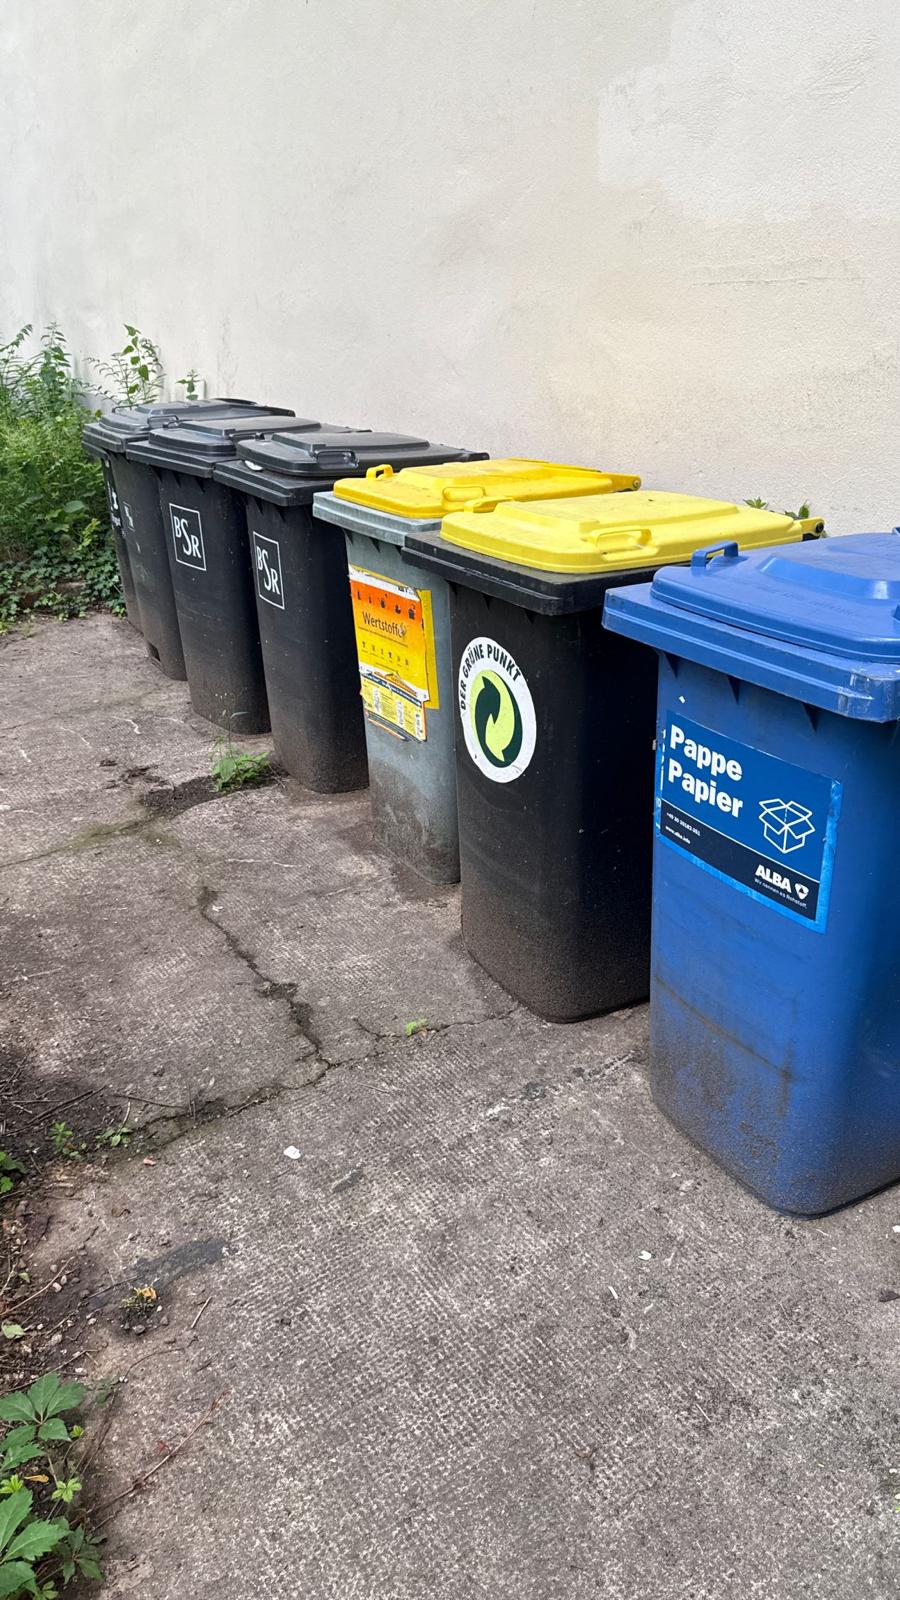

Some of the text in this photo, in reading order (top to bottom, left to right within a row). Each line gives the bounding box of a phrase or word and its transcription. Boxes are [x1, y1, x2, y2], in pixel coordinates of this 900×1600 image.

[173, 515, 201, 559] BSR
[256, 546, 281, 596] BSR
[462, 644, 485, 677] GRÜNE
[486, 643, 522, 682] PUNKT
[669, 724, 743, 782] Pappe
[668, 758, 744, 818] Papier
[754, 877, 762, 885] Wir
[755, 864, 792, 893] ALBA
